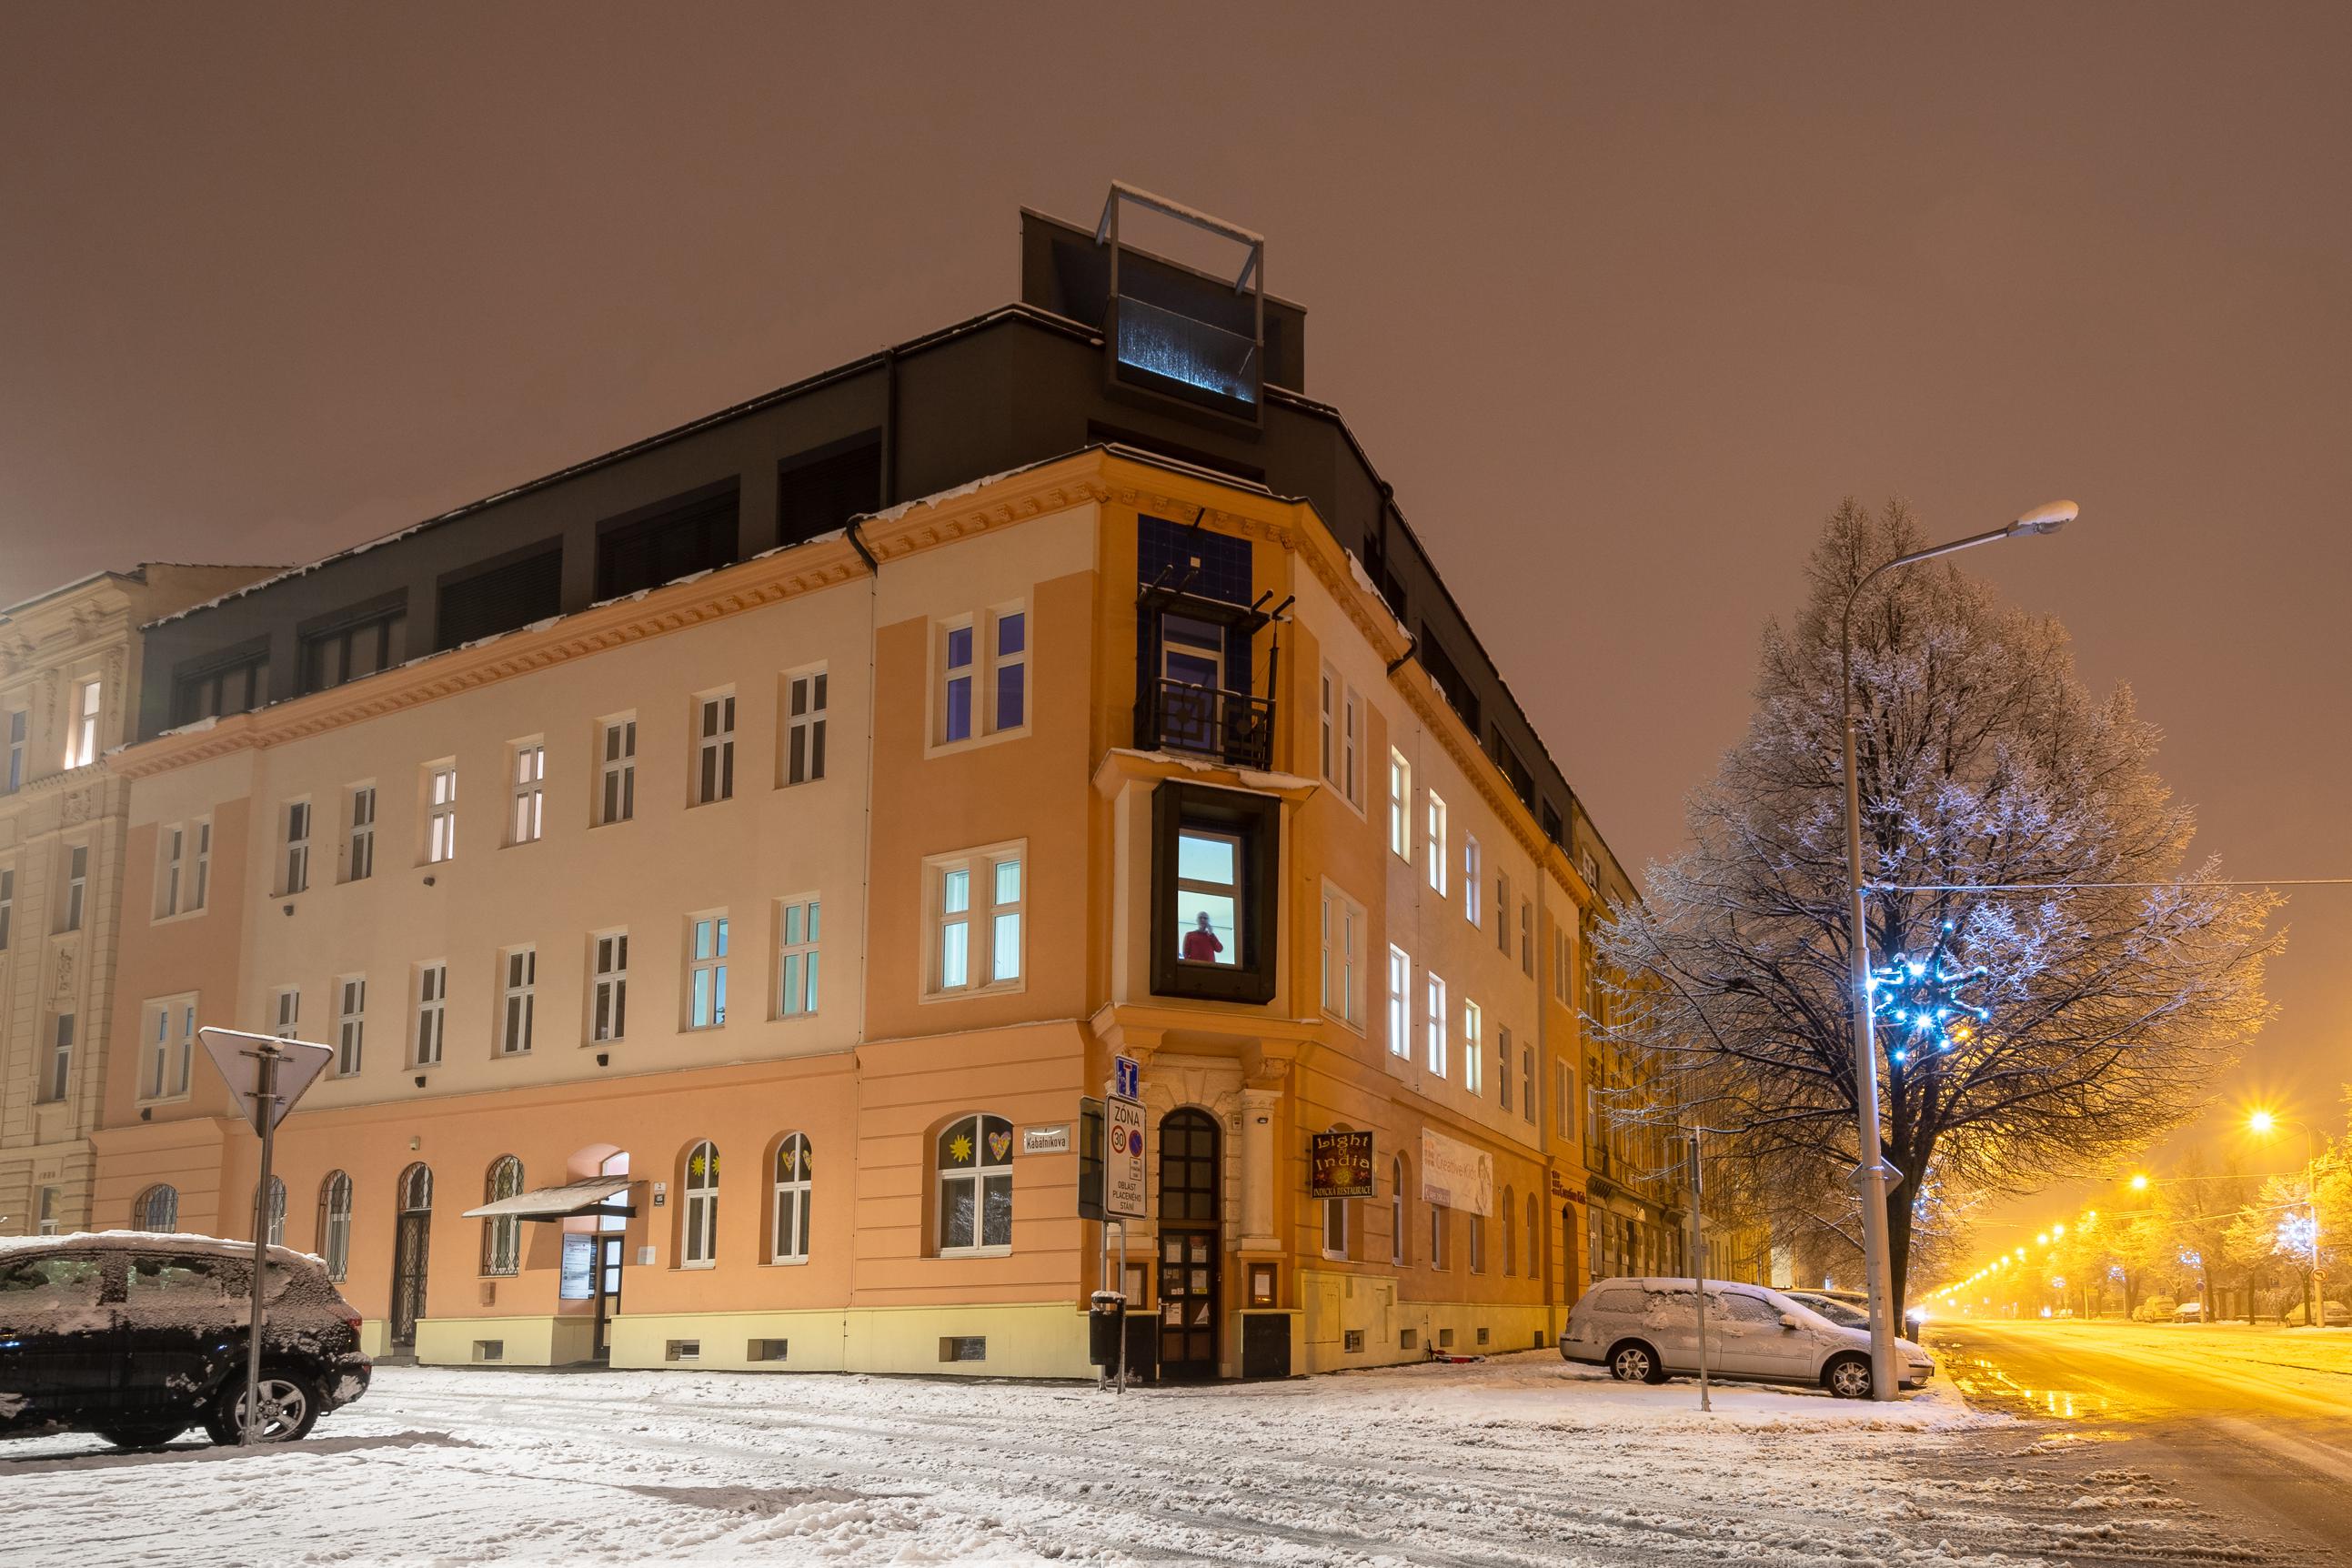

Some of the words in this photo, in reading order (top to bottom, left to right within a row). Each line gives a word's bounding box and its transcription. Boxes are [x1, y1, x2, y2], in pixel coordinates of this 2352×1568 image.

[1114, 1104, 1141, 1128] ZÓNA
[1114, 1131, 1124, 1147] 30
[1317, 1134, 1368, 1149] Light
[1338, 1148, 1348, 1158] of
[1316, 1154, 1370, 1171] India
[1118, 1181, 1136, 1192] OBLAST
[1337, 1185, 1372, 1196] RESTAURACE
[1112, 1190, 1141, 1202] PLACENÉHO
